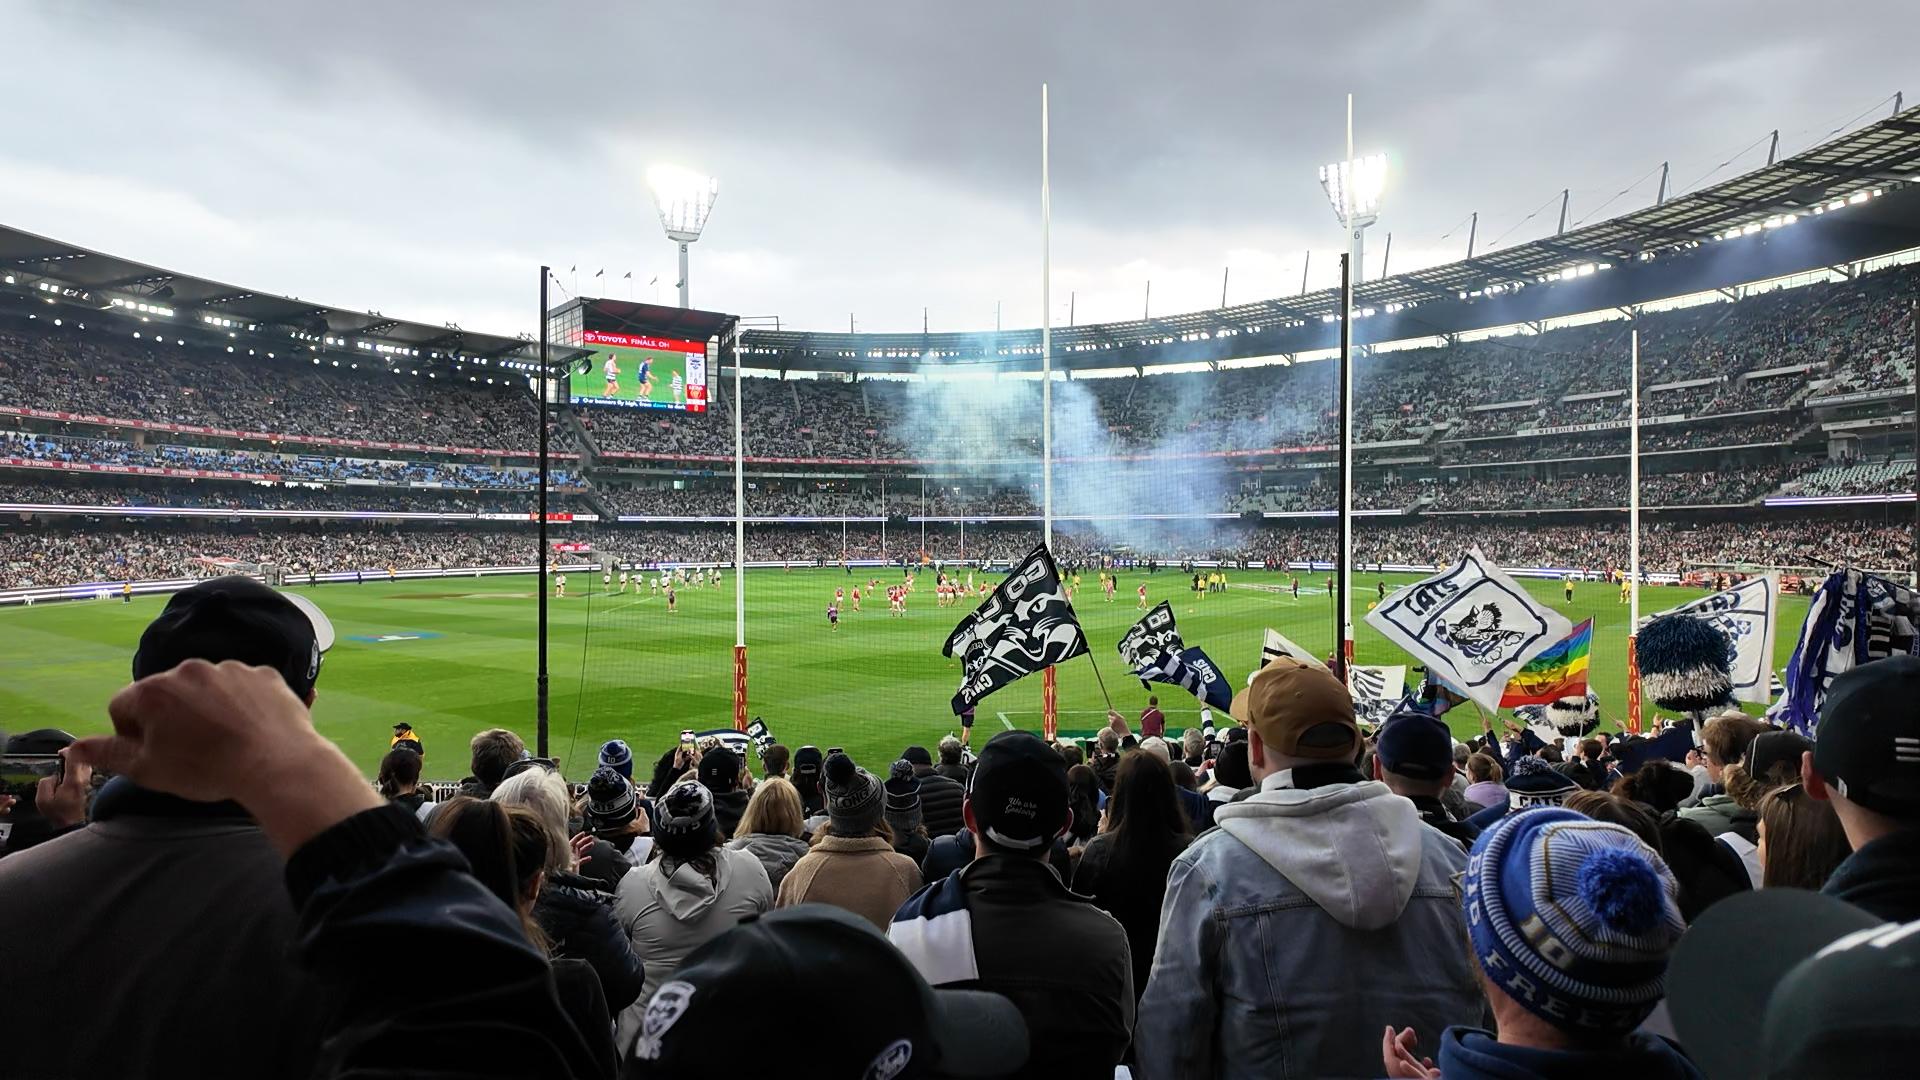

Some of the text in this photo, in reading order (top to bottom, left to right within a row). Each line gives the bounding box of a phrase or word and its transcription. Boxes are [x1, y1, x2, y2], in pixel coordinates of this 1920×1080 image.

[596, 334, 627, 344] TOYOTA
[40, 409, 59, 418] TOYOTA
[1538, 425, 1590, 434] MELBOURNE
[1594, 421, 1632, 430] CRICKET
[1404, 580, 1460, 617] CATS
[1519, 796, 1562, 808] CATS
[1468, 852, 1482, 927] BIG
[1518, 913, 1576, 970] 10
